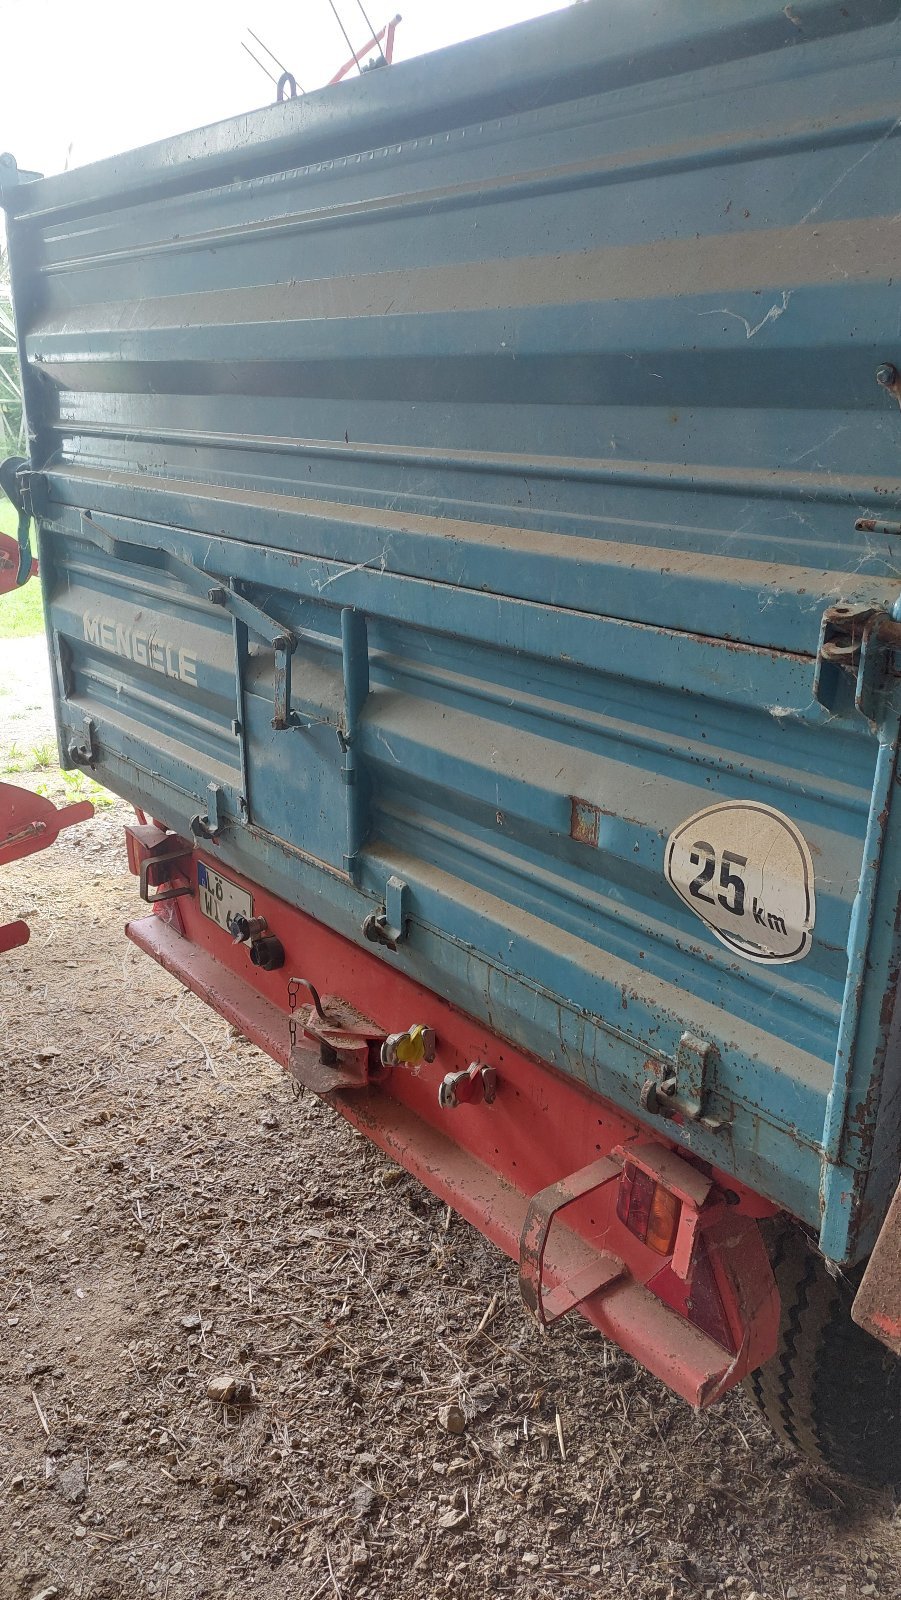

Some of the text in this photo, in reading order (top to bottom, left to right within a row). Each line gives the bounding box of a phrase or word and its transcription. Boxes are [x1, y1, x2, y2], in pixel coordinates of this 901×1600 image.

[83, 609, 198, 687] MENGELE
[204, 891, 221, 923] WI
[206, 872, 223, 901] LÖ
[689, 840, 788, 936] 25 km
